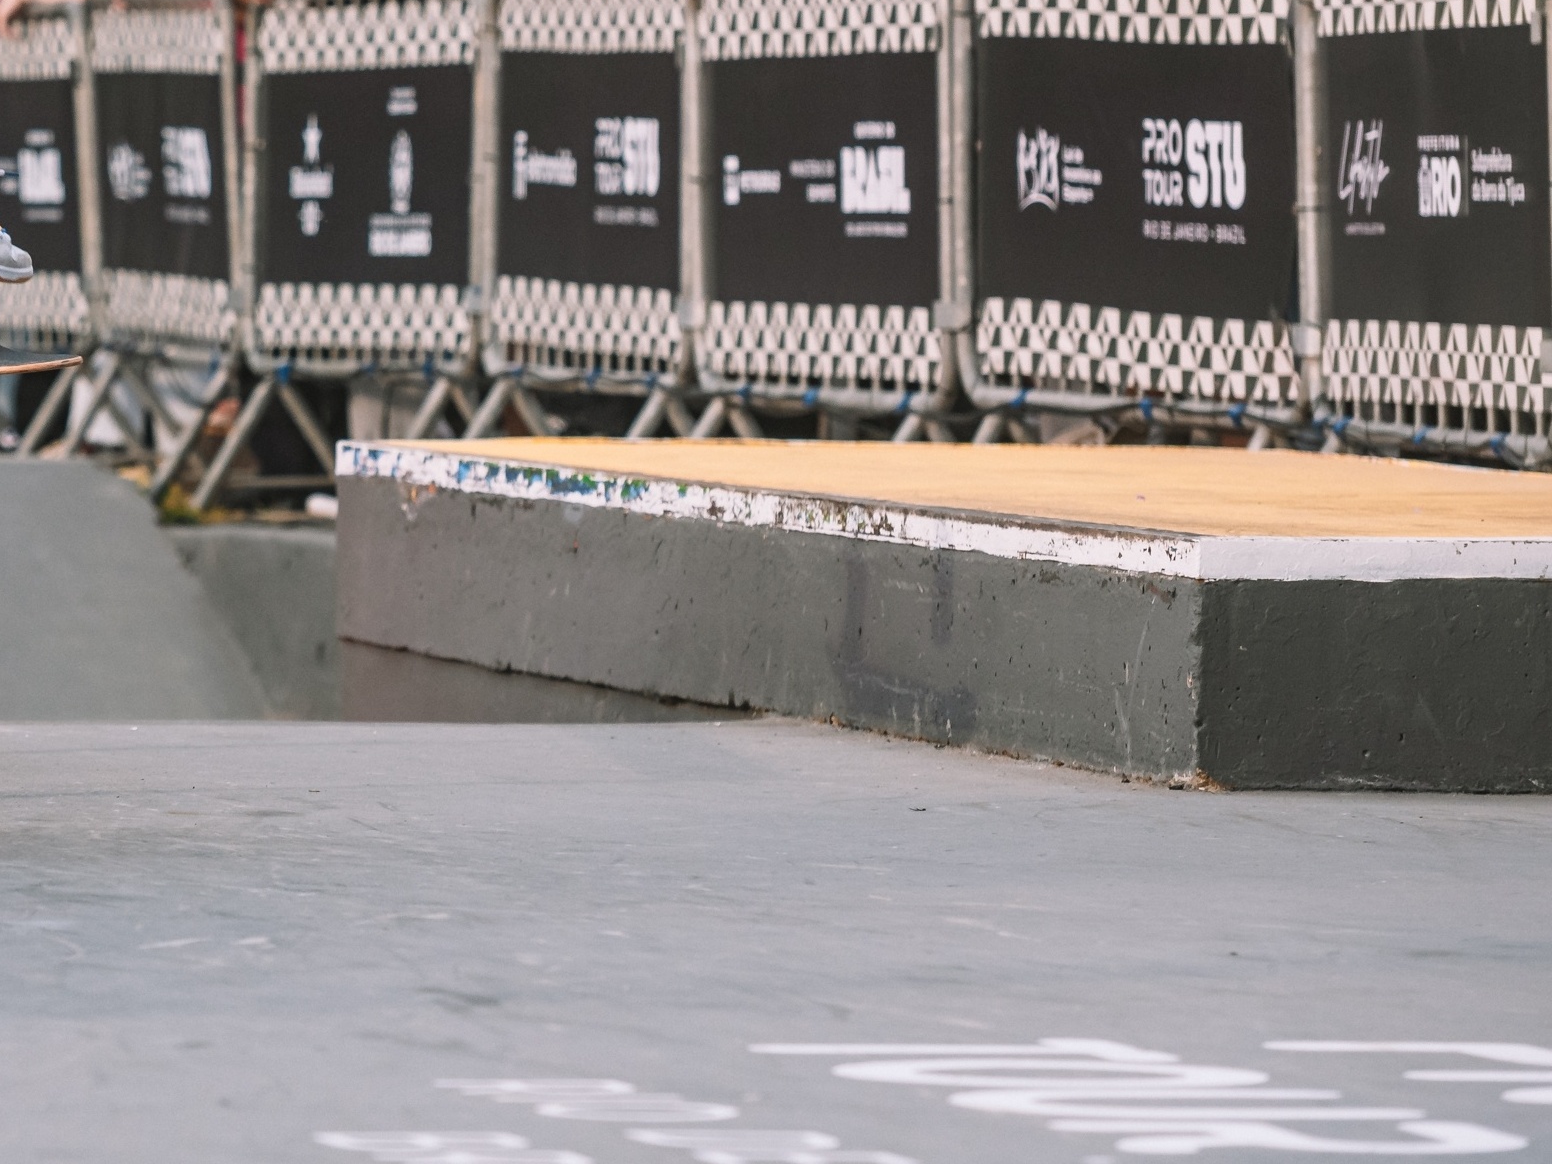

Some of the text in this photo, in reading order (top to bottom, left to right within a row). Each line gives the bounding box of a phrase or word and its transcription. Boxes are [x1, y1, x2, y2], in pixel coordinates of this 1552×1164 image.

[622, 116, 660, 197] STU
[1142, 117, 1183, 166] PRO
[1185, 118, 1246, 210] STU
[1142, 168, 1184, 207] TOUR
[1431, 156, 1461, 218] RIO
